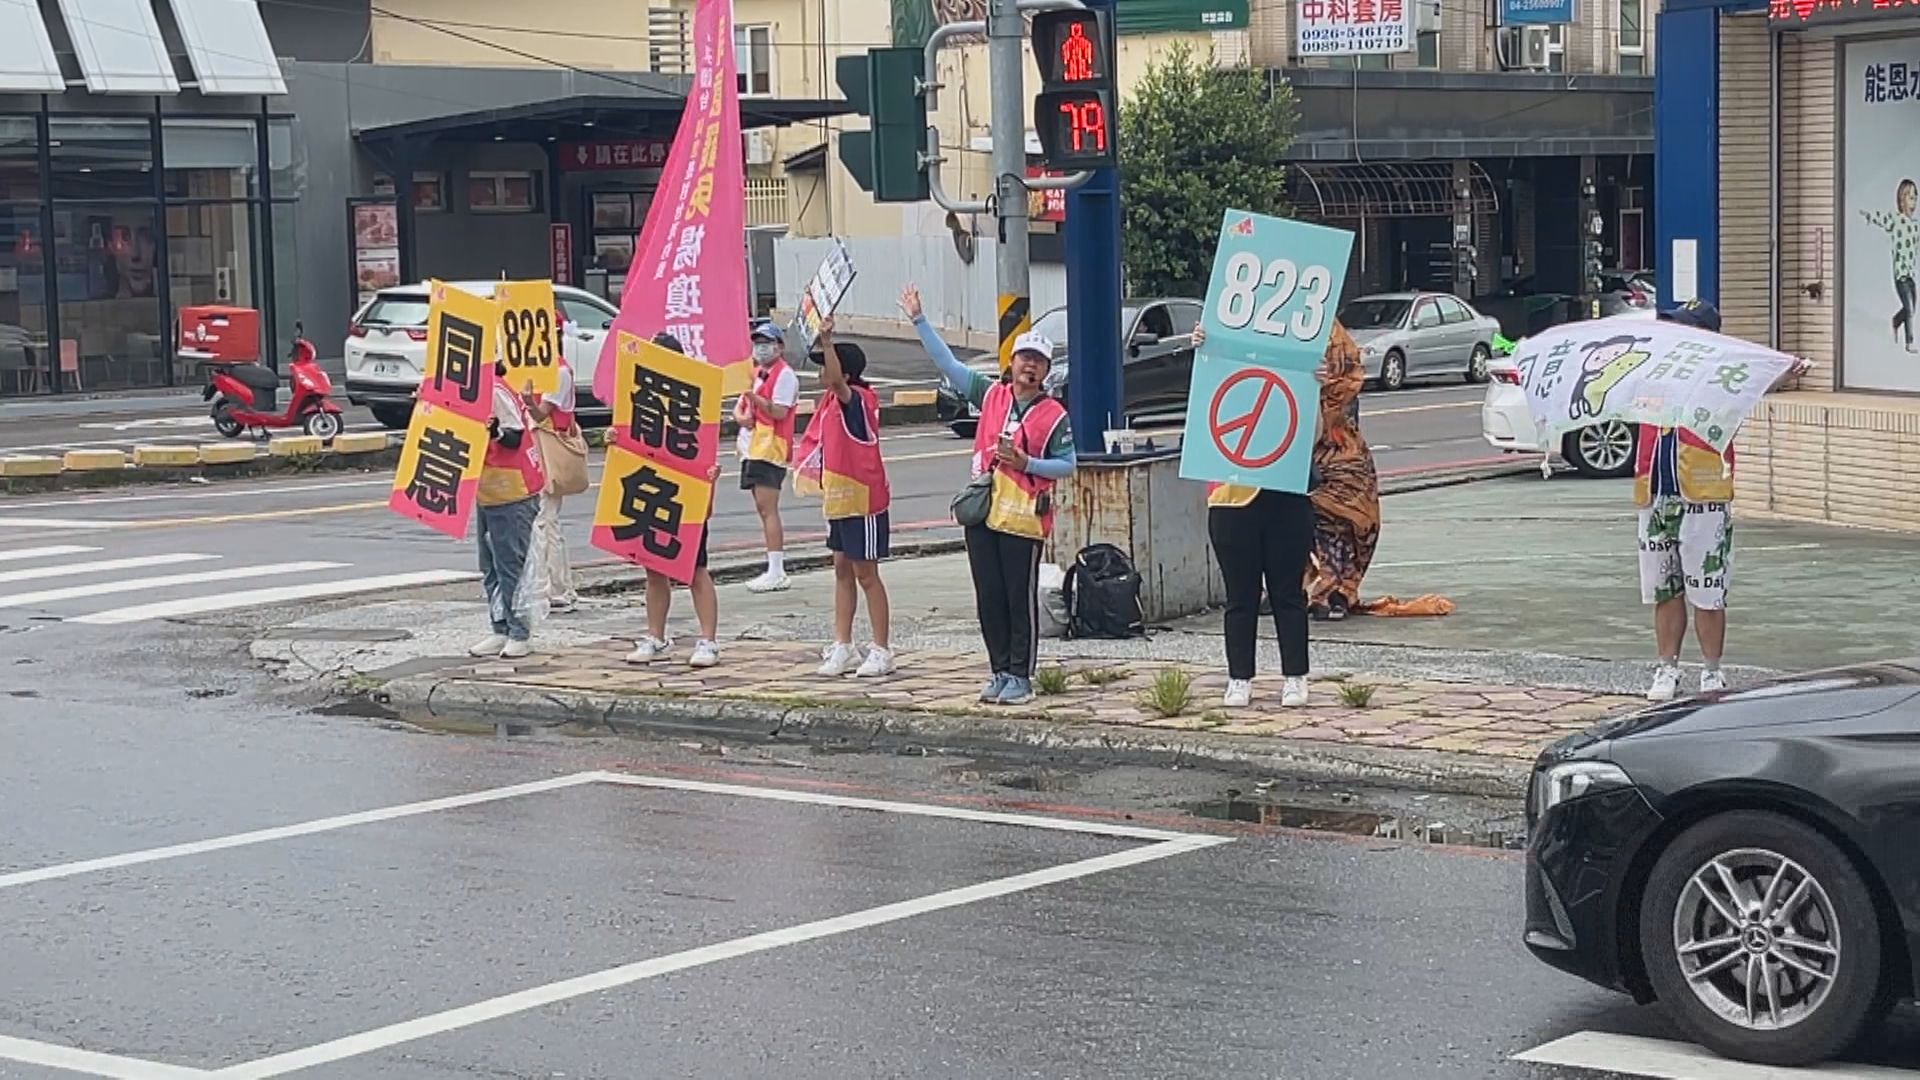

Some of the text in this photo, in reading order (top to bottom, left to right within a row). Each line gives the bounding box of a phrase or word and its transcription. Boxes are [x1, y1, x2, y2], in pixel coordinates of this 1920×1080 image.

[1302, 0, 1402, 26] 中科套房
[595, 143, 670, 165] 請在此停
[1060, 102, 1105, 151] 79
[1217, 251, 1332, 342] 823
[503, 308, 551, 368] 823
[405, 311, 483, 516] 同意
[611, 363, 702, 560] 罷免
